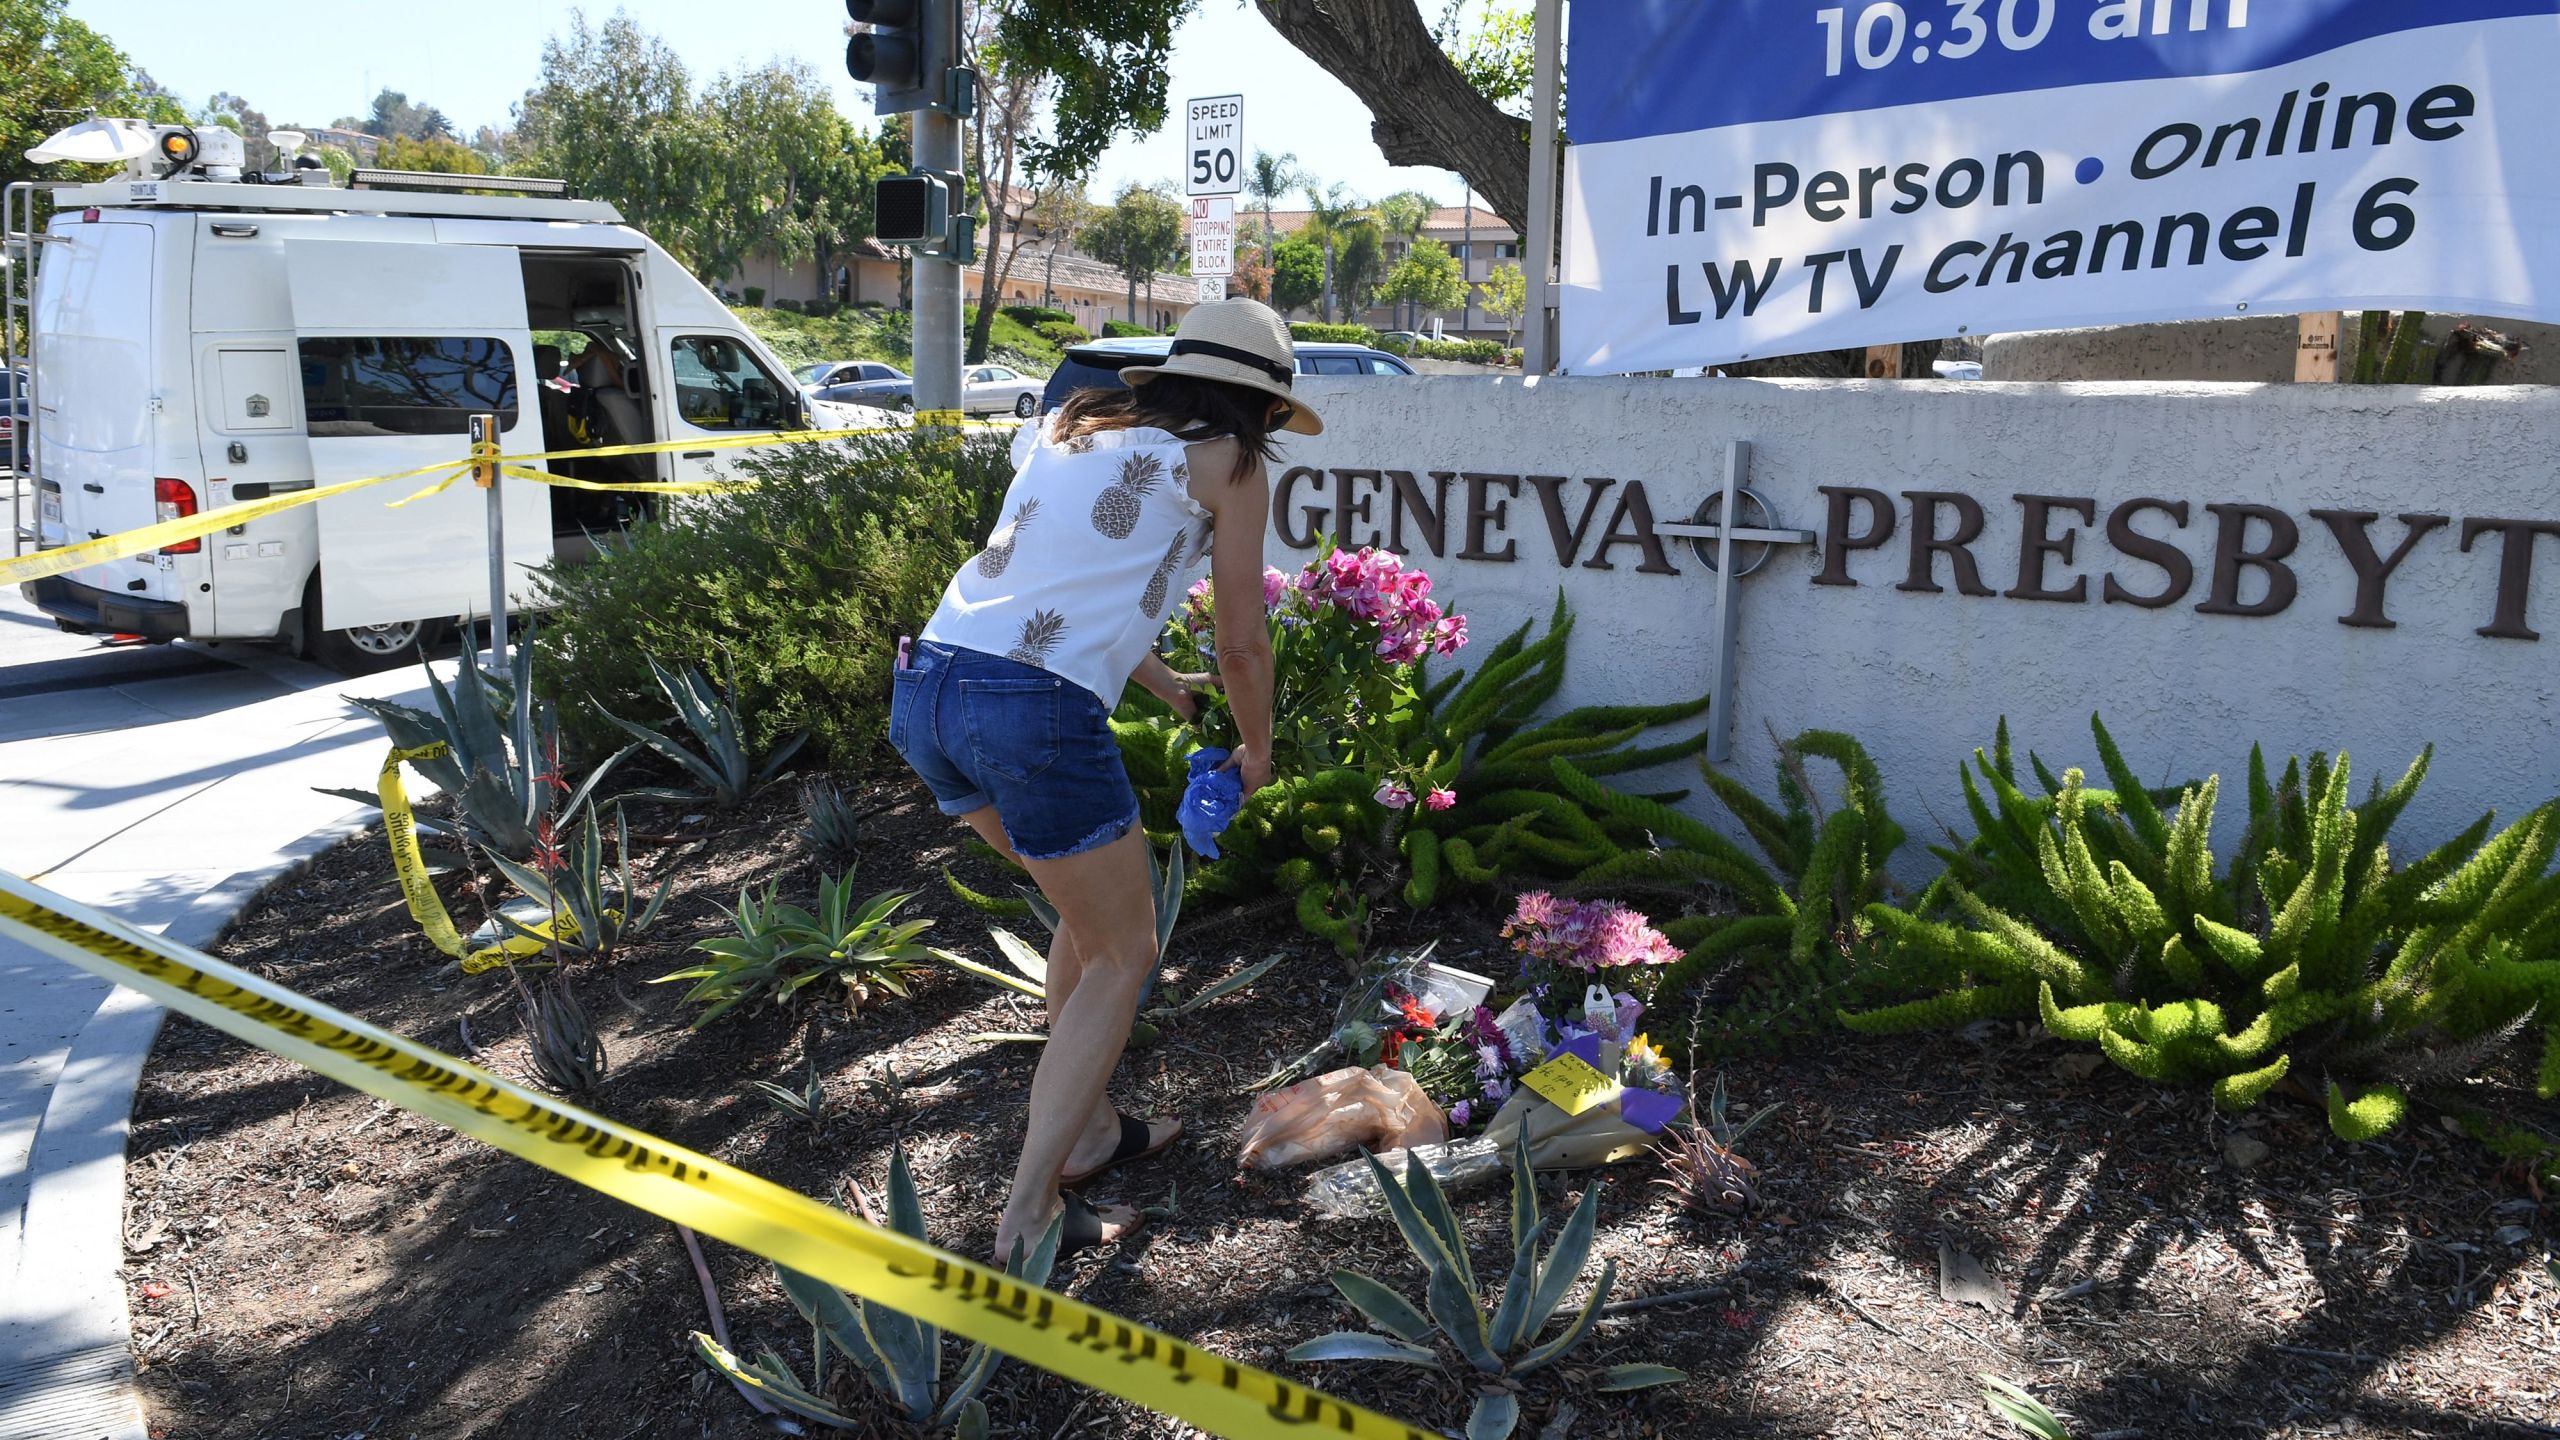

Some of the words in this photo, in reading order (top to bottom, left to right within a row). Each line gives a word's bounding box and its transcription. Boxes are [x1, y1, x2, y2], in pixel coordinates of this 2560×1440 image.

[1816, 0, 2055, 76] 10:30
[1192, 103, 1238, 120] SPEED
[1197, 124, 1232, 140] LIMIT
[1193, 148, 1235, 184] 50
[1647, 150, 2044, 236] In-Person
[2130, 81, 2475, 180] Online
[1193, 200, 1207, 218] NO
[1195, 220, 1230, 236] STOPPING
[1197, 239, 1227, 252] ENTIRE
[1667, 257, 1782, 326] LW
[1803, 244, 1904, 313] TV
[1923, 181, 2316, 294] Channel
[2352, 177, 2420, 251] 6
[1198, 255, 1226, 268] BLOCK
[1272, 466, 1680, 576] GENEVA
[1812, 486, 2560, 640] PRESBYT
